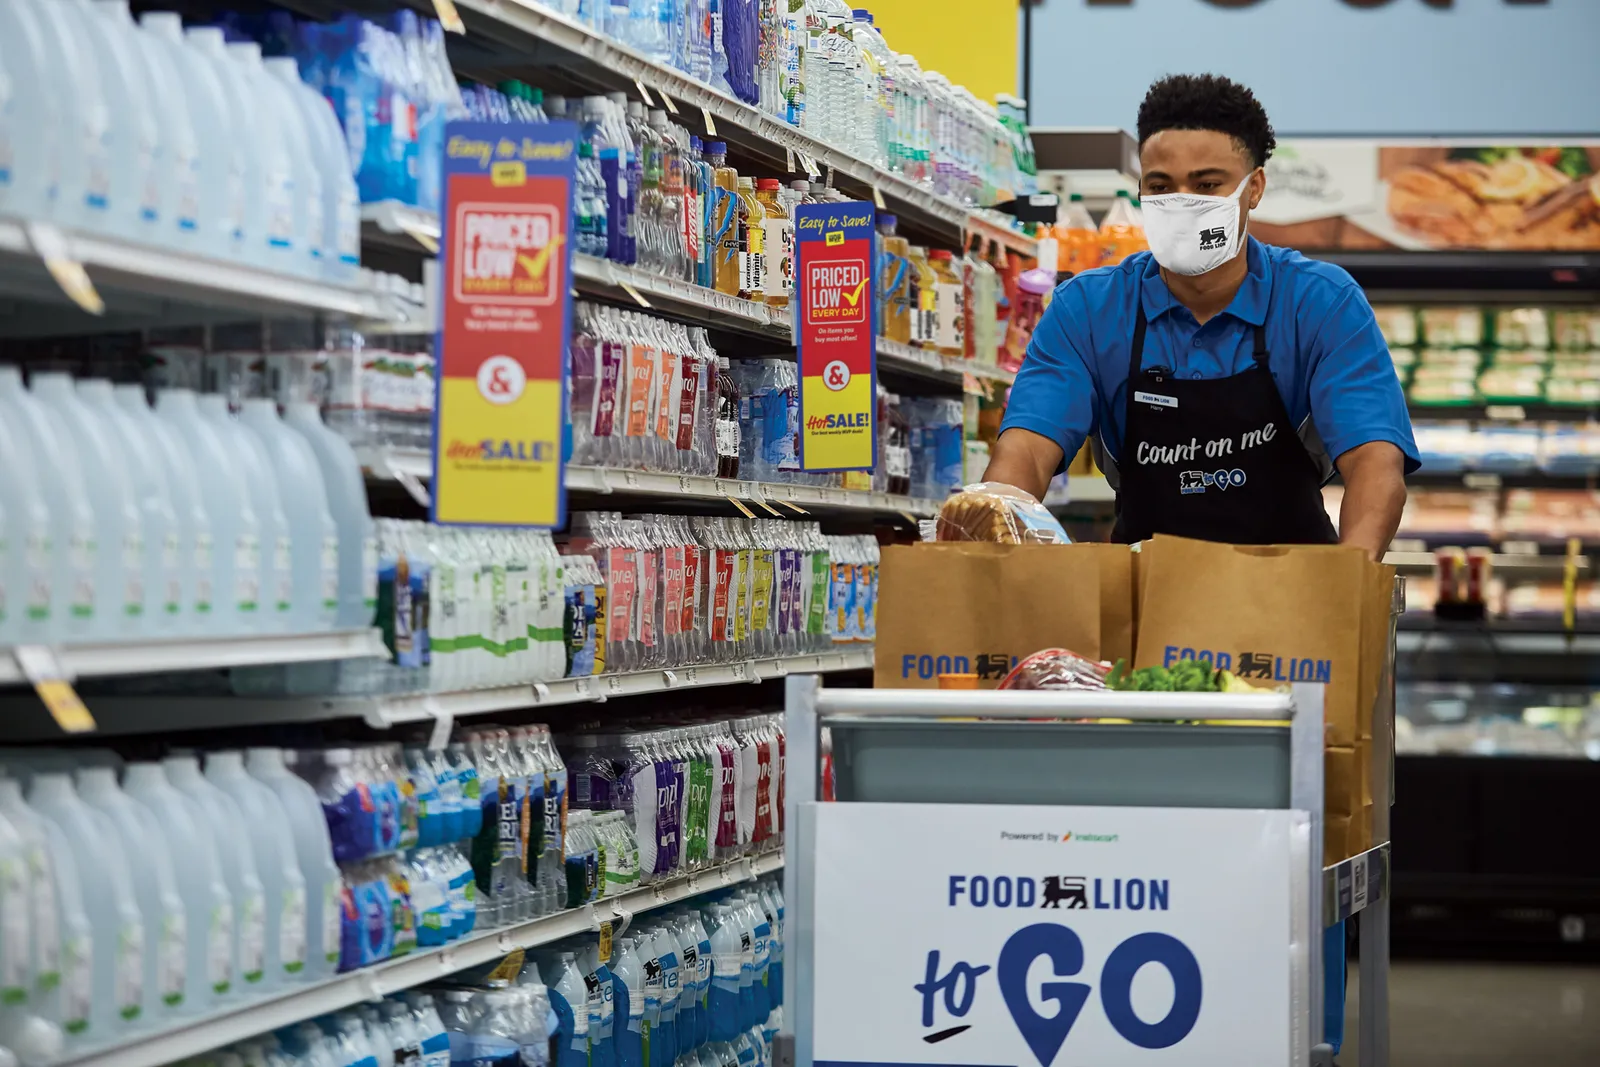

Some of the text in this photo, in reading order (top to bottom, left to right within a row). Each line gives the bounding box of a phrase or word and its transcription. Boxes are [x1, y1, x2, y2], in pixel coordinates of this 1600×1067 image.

[465, 213, 549, 248] PRICED
[799, 216, 825, 236] Easy
[828, 216, 839, 227] to
[841, 214, 871, 227] Save!
[465, 247, 517, 278] LOW
[812, 266, 860, 287] PRICED
[812, 289, 841, 308] LOW
[812, 308, 859, 317] EVERY DAY
[1137, 422, 1277, 465] Count on me
[1214, 468, 1247, 491] GO
[902, 654, 969, 679] FOOD
[1275, 656, 1332, 683] LION
[1001, 831, 1044, 841] Powered
[1047, 832, 1059, 843] by
[948, 876, 1169, 911] FOOD LION
[913, 922, 1204, 1067] to GO
